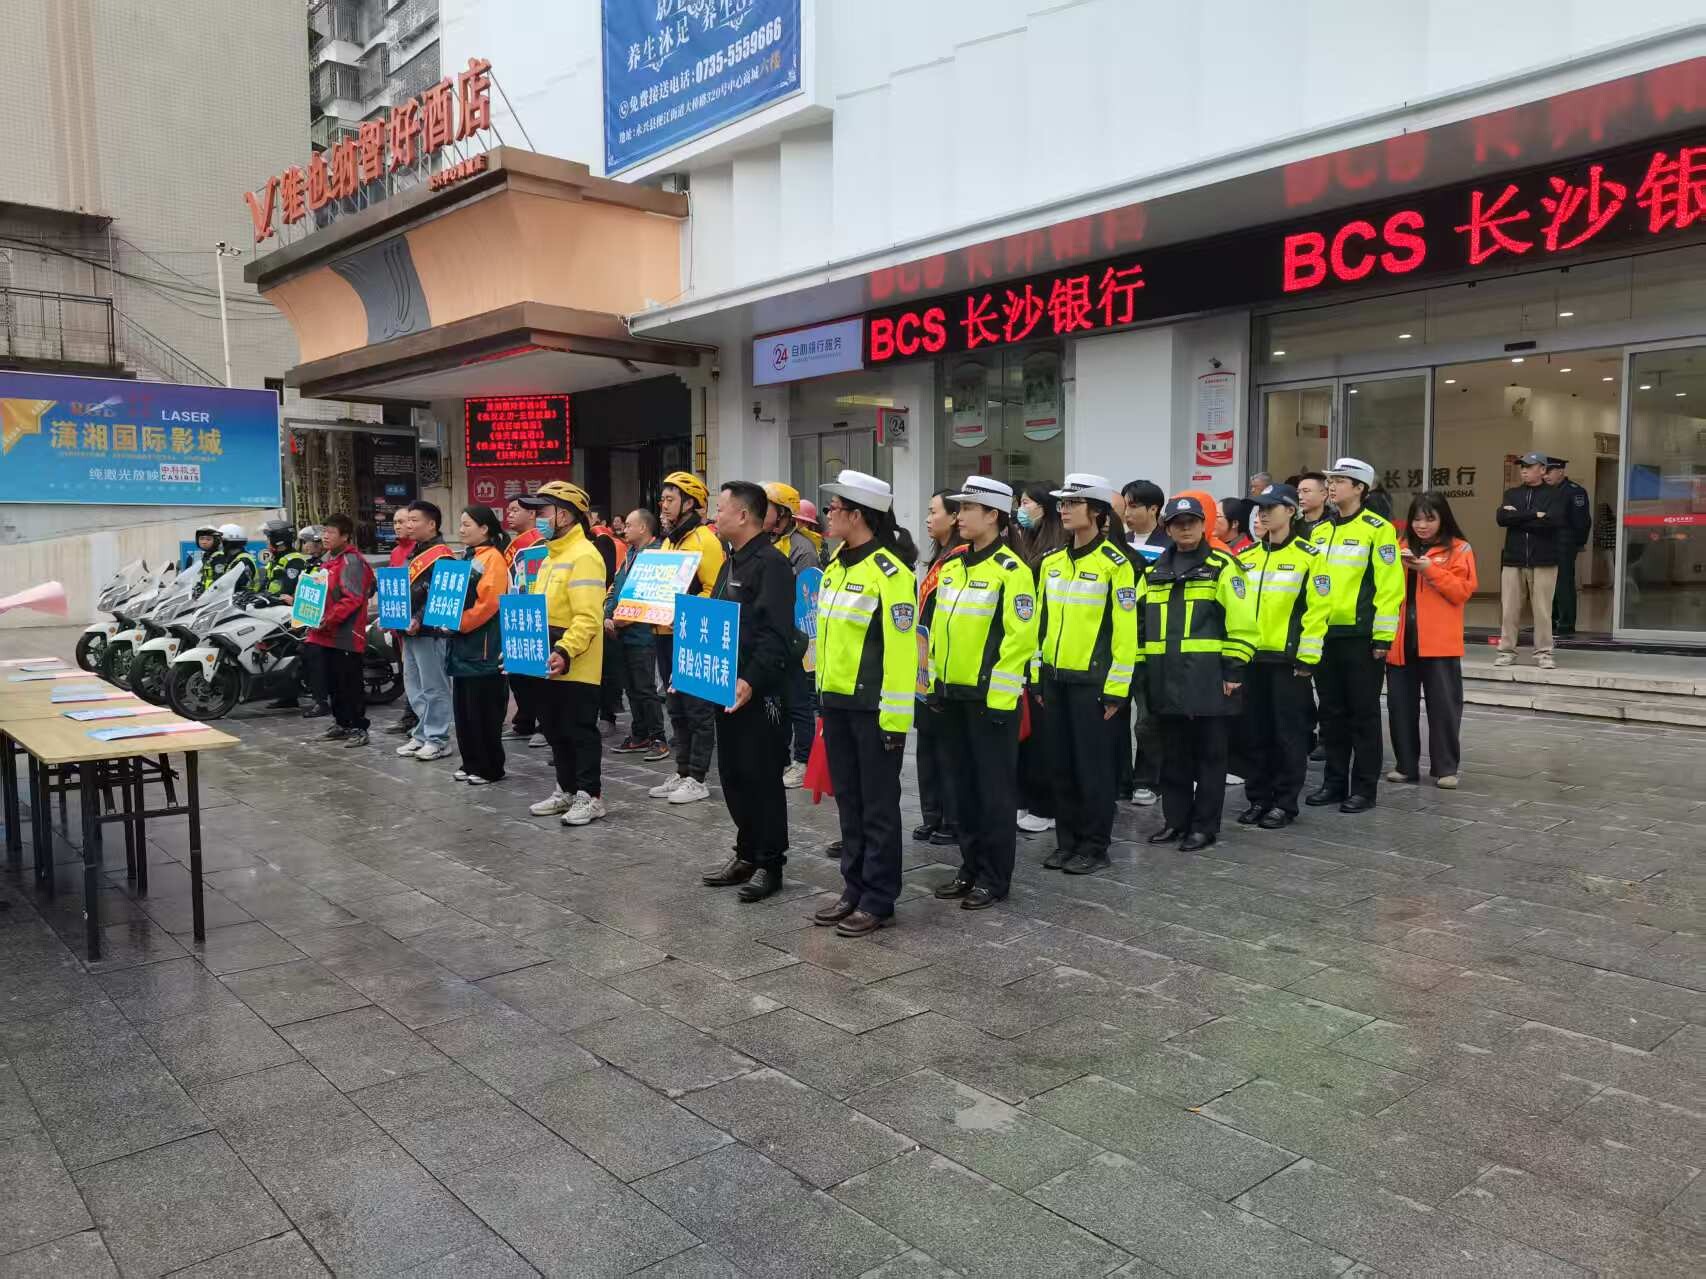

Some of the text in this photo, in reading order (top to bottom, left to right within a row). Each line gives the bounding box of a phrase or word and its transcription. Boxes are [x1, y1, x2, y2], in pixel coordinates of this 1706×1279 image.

[281, 57, 492, 225] 维也纳智好酒店
[1282, 210, 1427, 293] BCS
[959, 263, 1145, 350] 长沙银行
[870, 307, 947, 361] BCS
[161, 410, 210, 424] LASER
[51, 420, 224, 456] 潇湘国际影城
[434, 571, 465, 592] 中国邮政
[428, 595, 461, 618] 永兴分公司
[503, 608, 542, 632] 永兴县外卖
[505, 637, 544, 661] 快递公司代表
[679, 611, 731, 651] 永兴县
[678, 646, 730, 687] 保险公司代表
